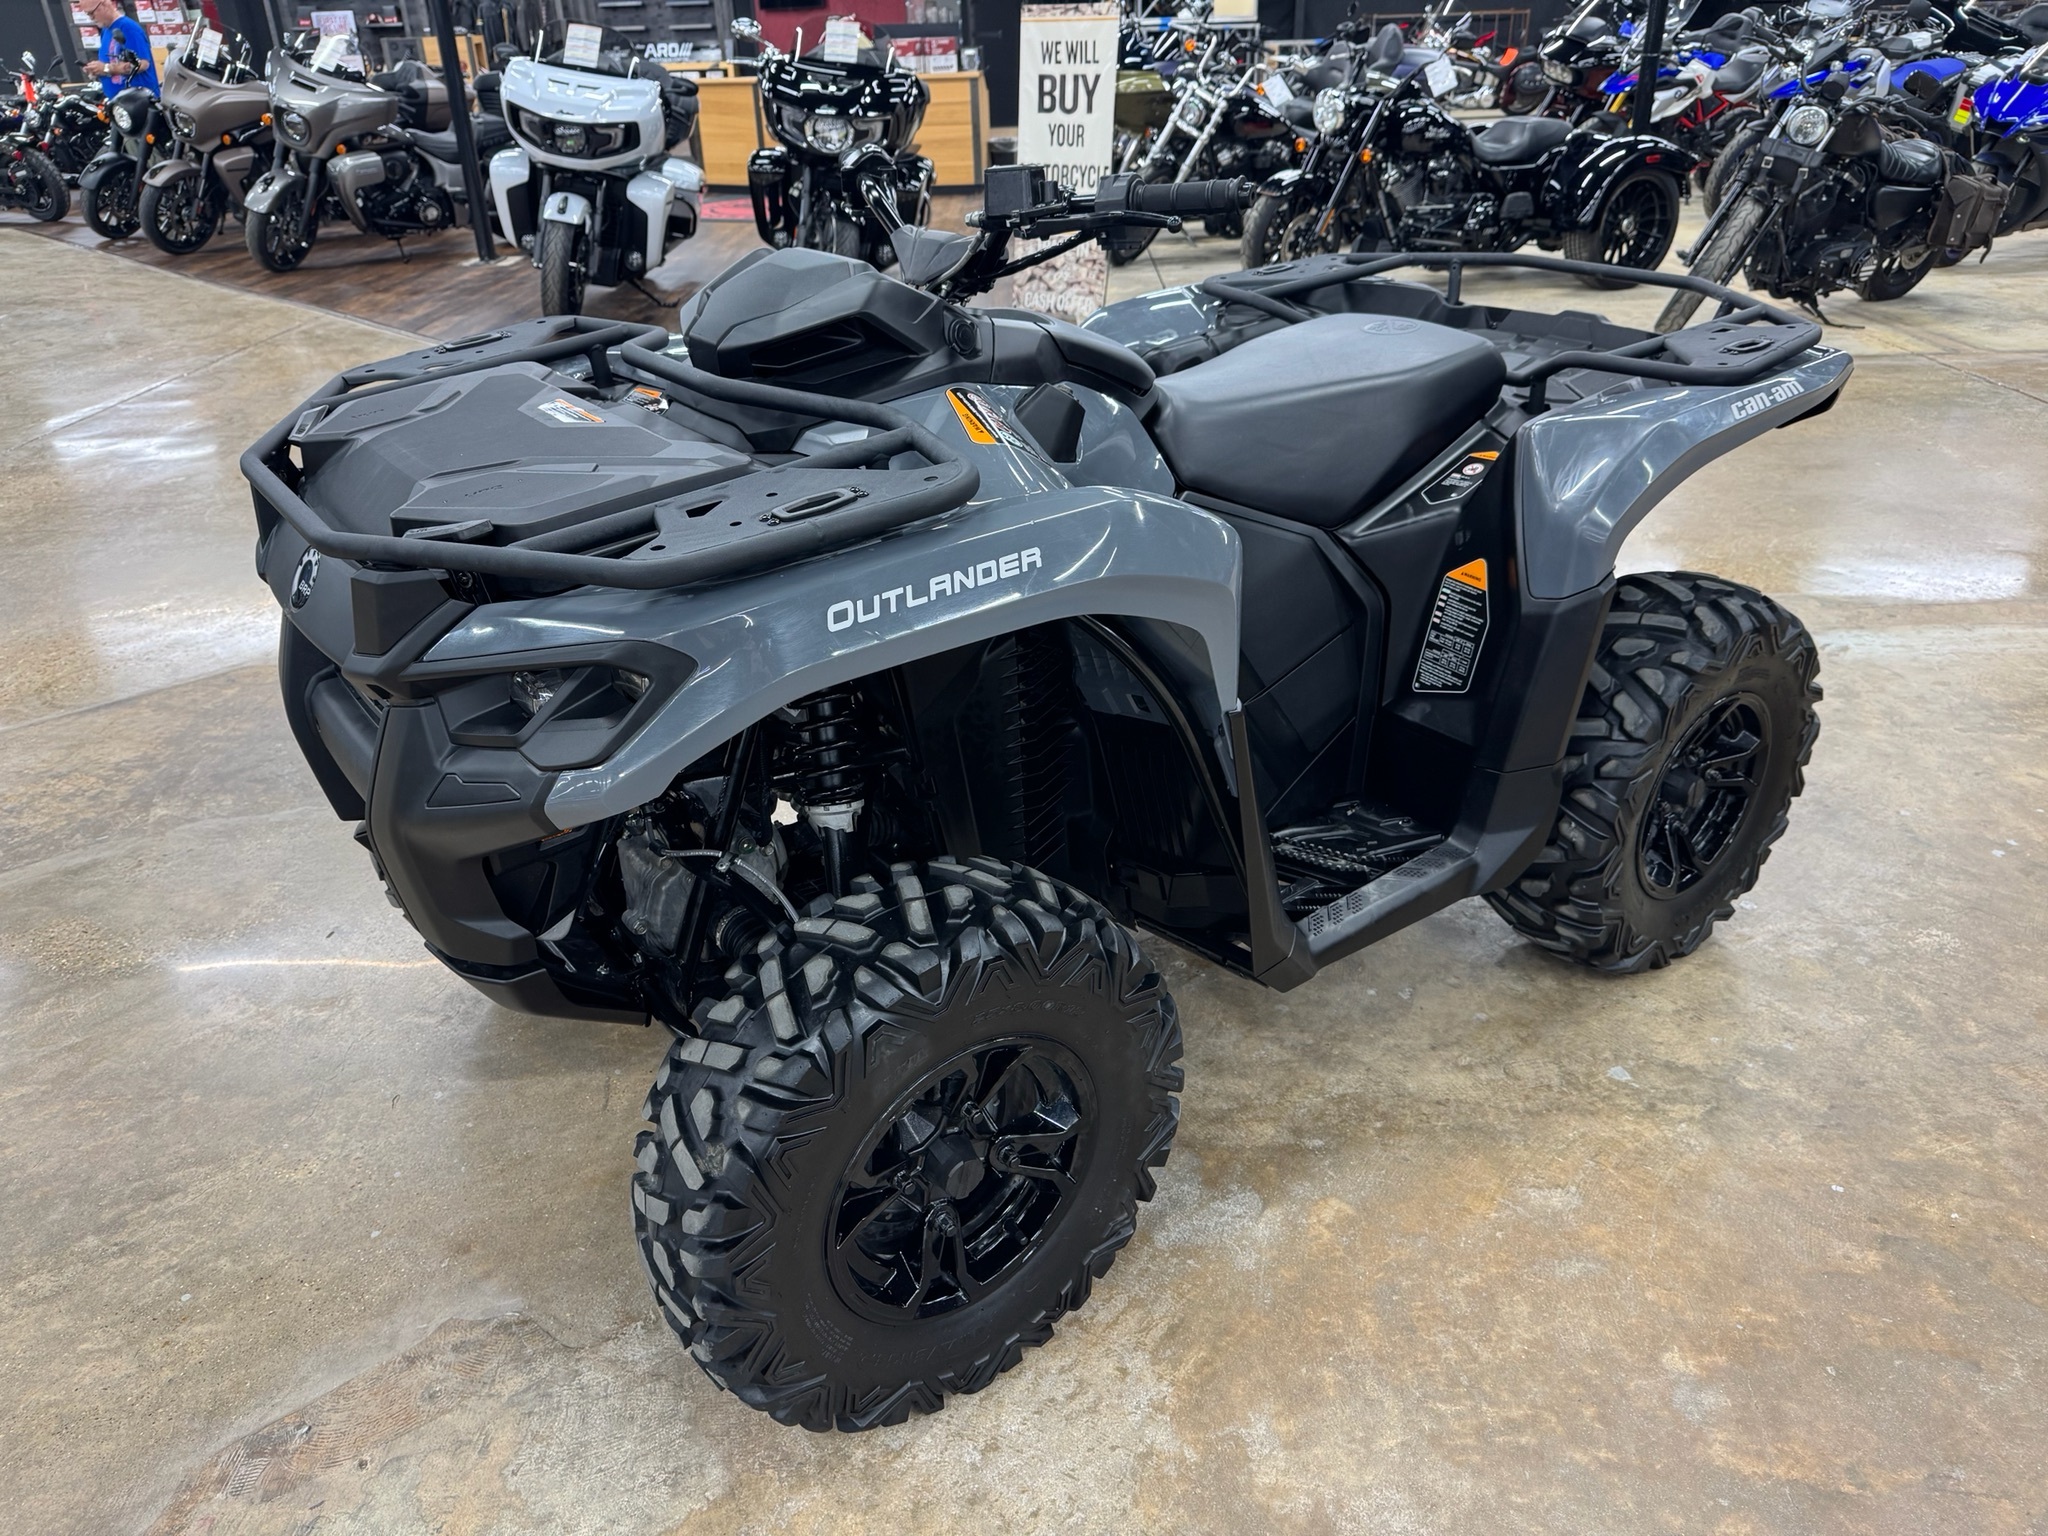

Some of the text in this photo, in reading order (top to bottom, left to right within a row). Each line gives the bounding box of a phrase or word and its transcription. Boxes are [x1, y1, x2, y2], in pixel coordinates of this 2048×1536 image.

[1041, 40, 1100, 64] WE WILL
[1038, 73, 1101, 115] BUY
[1048, 123, 1085, 147] YOUR
[1021, 163, 1110, 189] TORCYC
[1024, 291, 1055, 313] CASH
[299, 580, 311, 596] BRP
[826, 546, 1043, 633] OUTLANDER
